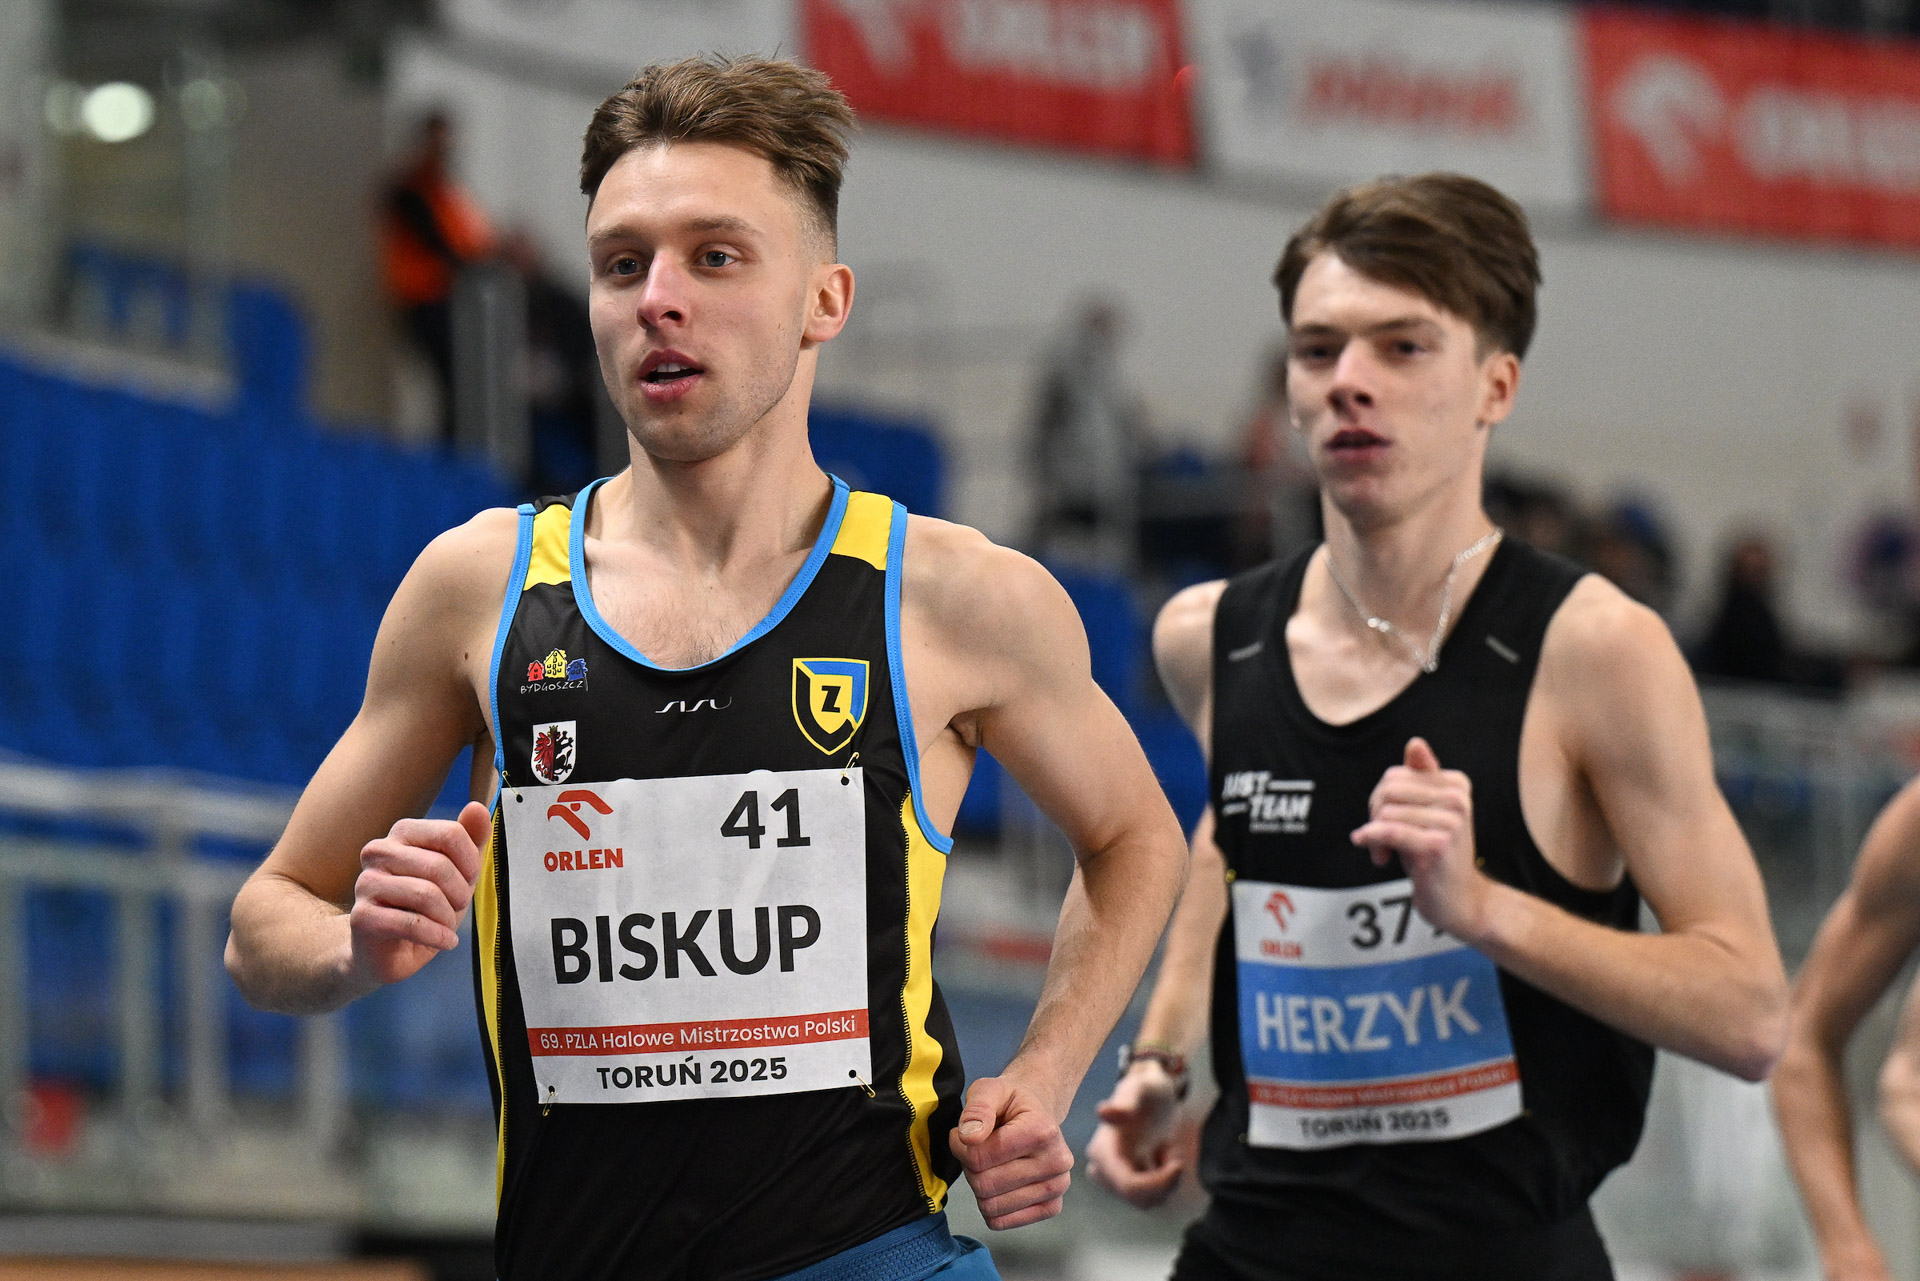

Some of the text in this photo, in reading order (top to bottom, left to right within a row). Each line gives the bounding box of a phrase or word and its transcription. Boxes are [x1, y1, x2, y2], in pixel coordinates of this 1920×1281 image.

[520, 680, 584, 695] BYDGOSZCZ
[821, 685, 841, 714] Z
[720, 788, 811, 850] 41
[543, 848, 624, 872] ORLEN
[1347, 896, 1446, 949] 37
[550, 904, 821, 985] BISKUP
[540, 1015, 856, 1050] 69. PZLA Halowe Mistrzostwa Polski
[1255, 977, 1481, 1055] HERZYK
[597, 1055, 787, 1090] TORUŃ 2025
